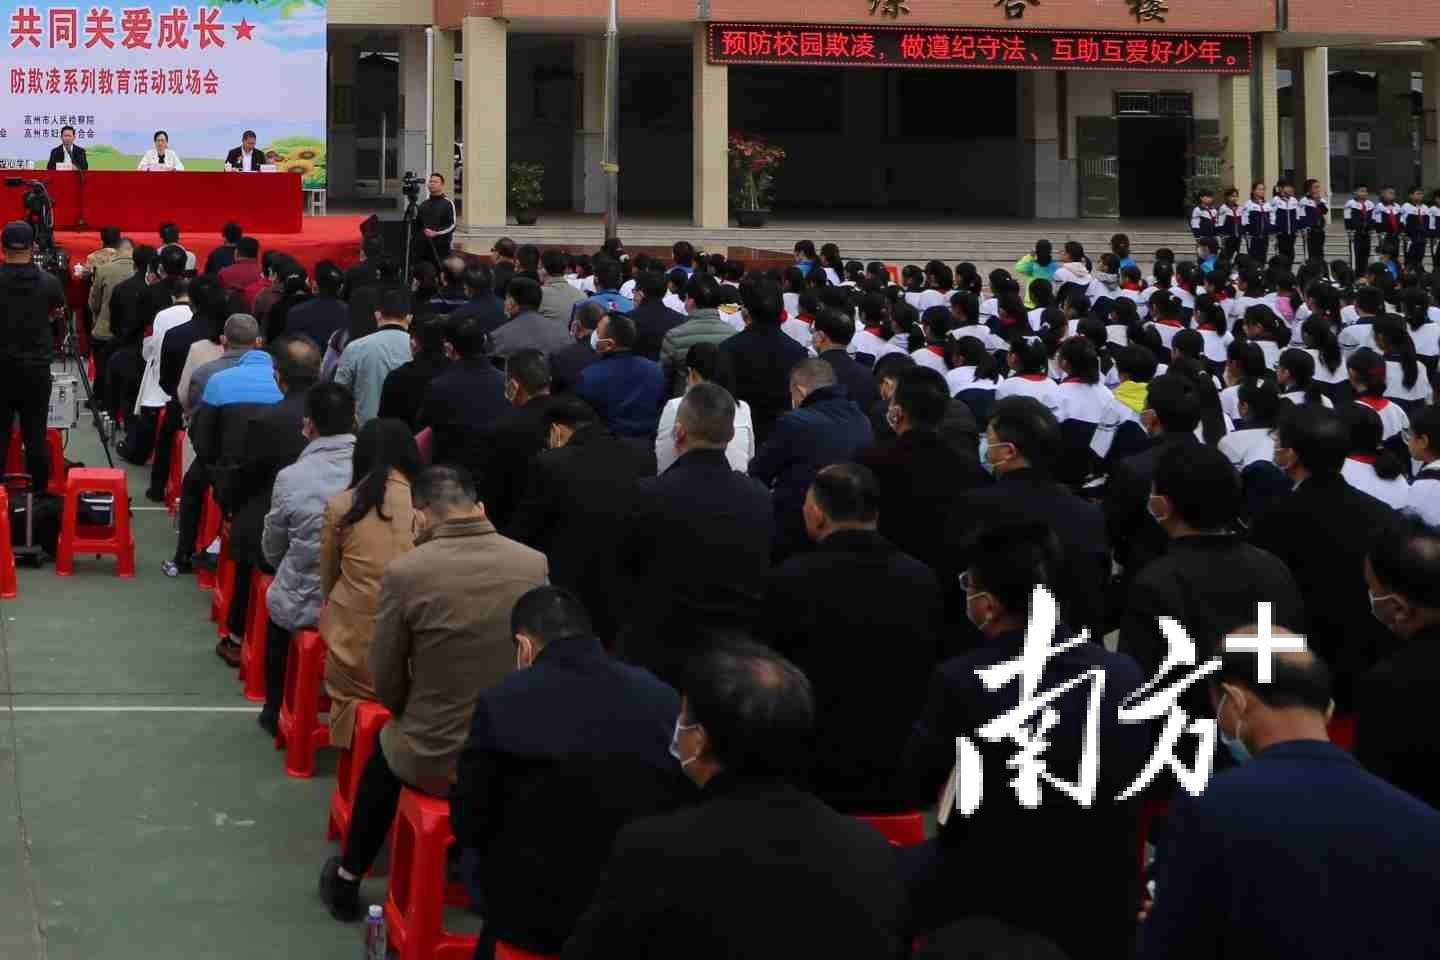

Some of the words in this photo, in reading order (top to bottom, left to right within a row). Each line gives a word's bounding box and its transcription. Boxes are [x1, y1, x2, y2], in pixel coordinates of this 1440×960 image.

[9, 7, 226, 50] 共同关爱成长
